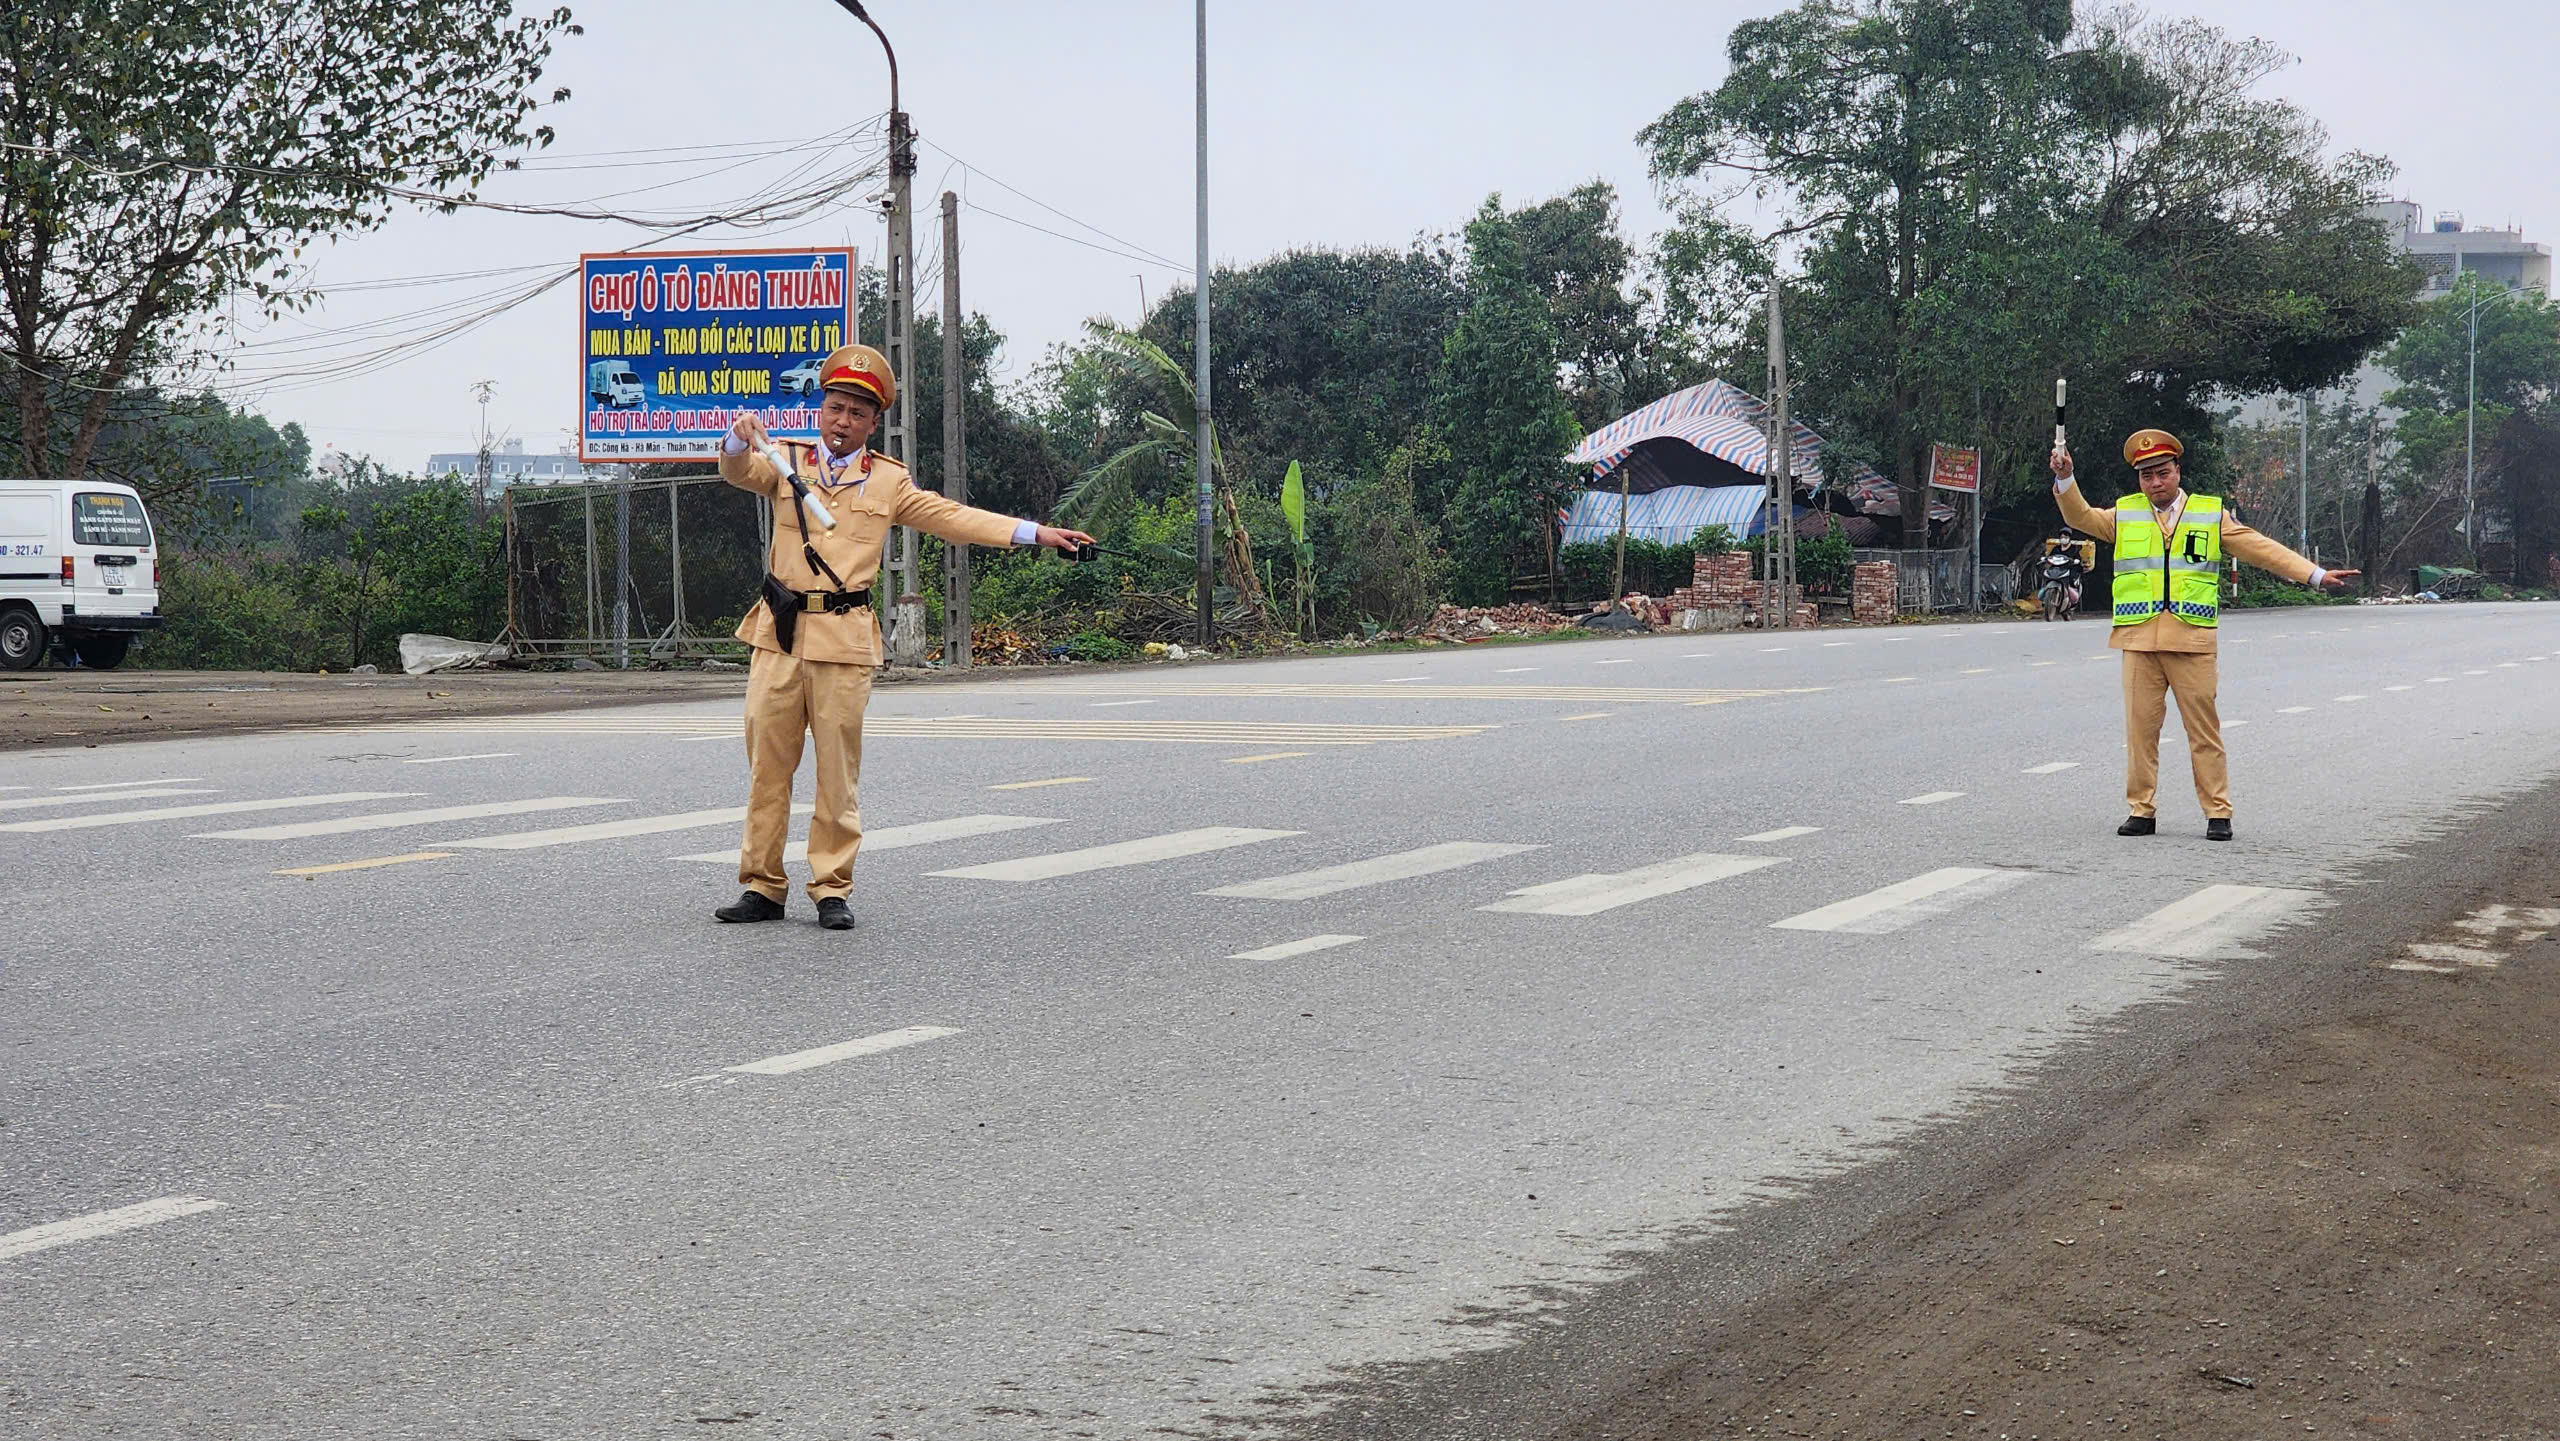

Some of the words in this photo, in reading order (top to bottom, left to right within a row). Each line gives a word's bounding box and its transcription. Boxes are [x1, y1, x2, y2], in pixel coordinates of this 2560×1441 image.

[590, 271, 638, 320] CHỢ
[641, 265, 658, 312] Ô
[662, 265, 692, 312] TÔ
[696, 264, 760, 310] ĐĂNG
[765, 256, 843, 310] THUẦN
[591, 329, 620, 355] MUA
[624, 323, 651, 355] BÁN
[664, 328, 697, 354] TRAO
[700, 317, 722, 354] ĐỔI
[727, 322, 753, 353] CÁC
[757, 326, 785, 359] LOẠI
[789, 325, 806, 352] XE
[811, 319, 820, 352] Ô
[824, 319, 840, 352] TÔ
[658, 366, 676, 394] ĐÃ
[680, 370, 707, 397] QUA
[711, 360, 731, 394] SỬ
[733, 369, 770, 399] DỤNG
[590, 403, 605, 432] HỖ
[607, 409, 627, 436] TRỢ
[629, 402, 649, 432] TRẢ
[652, 406, 672, 431] GÓP
[675, 410, 698, 433] QUA
[699, 405, 729, 431] NGÂN
[762, 404, 780, 429] LÃI
[782, 402, 808, 430] SUẤT
[667, 442, 686, 454] Thuận
[15, 544, 44, 556] 321.47
